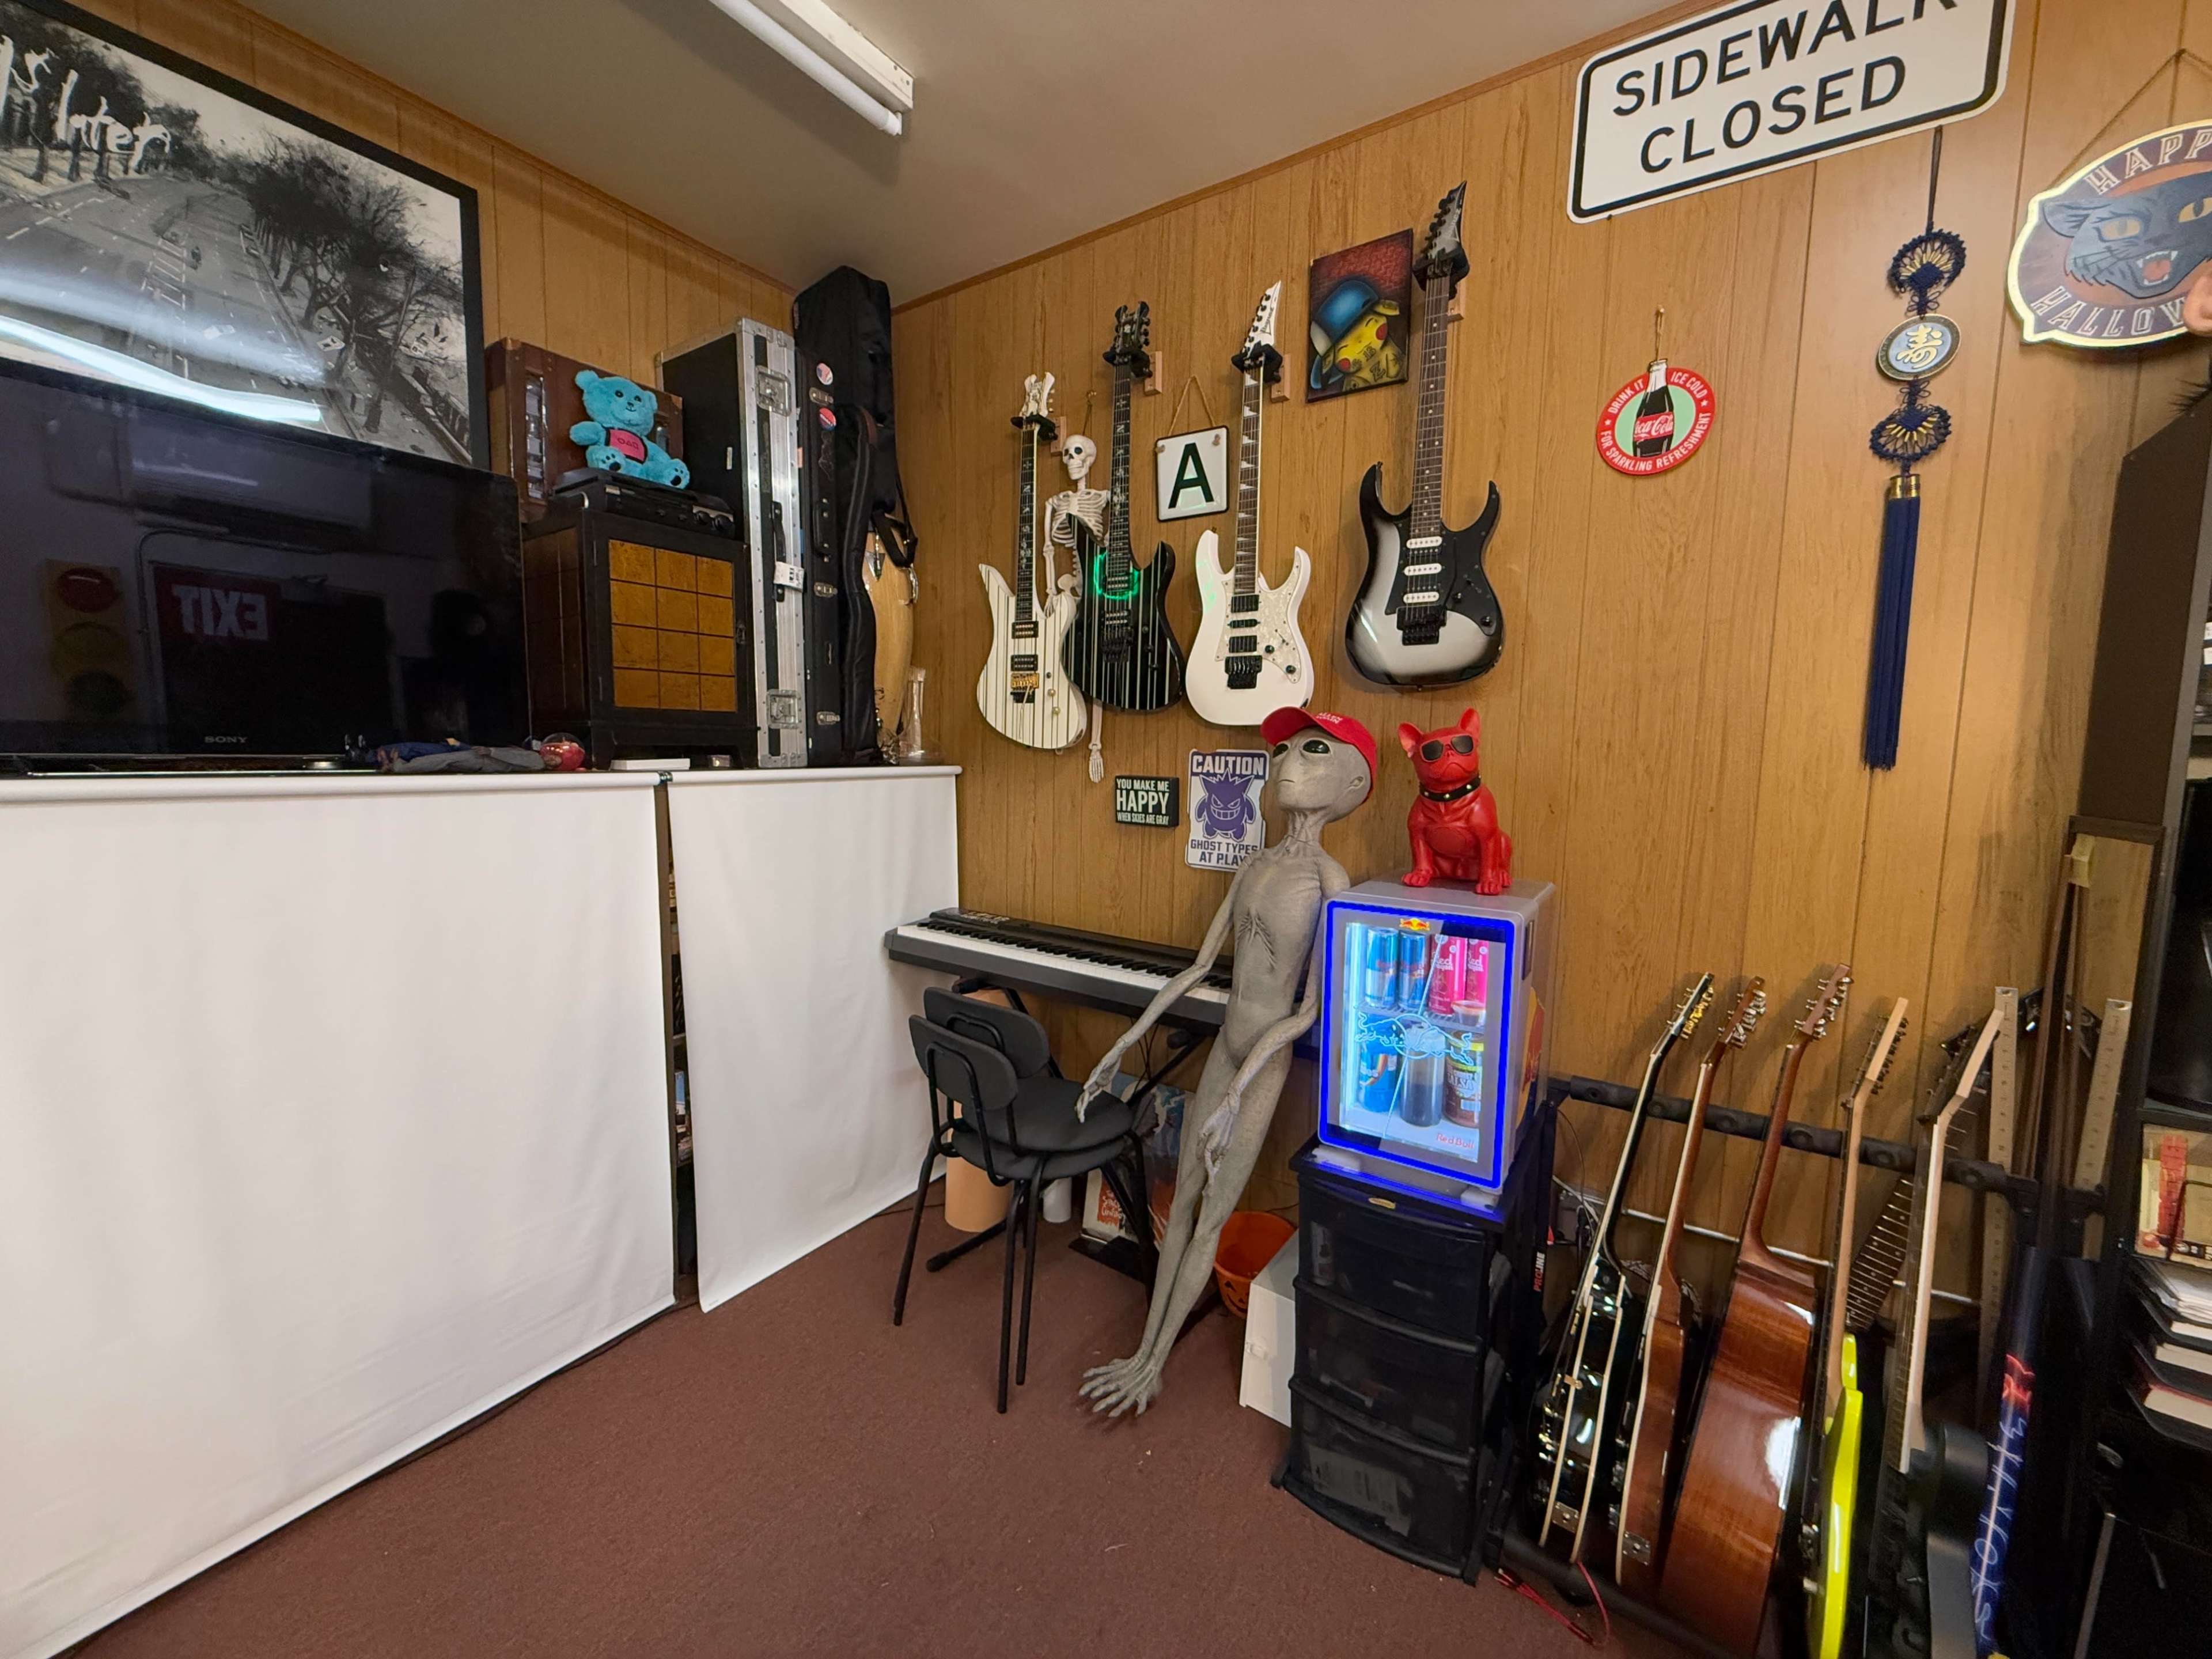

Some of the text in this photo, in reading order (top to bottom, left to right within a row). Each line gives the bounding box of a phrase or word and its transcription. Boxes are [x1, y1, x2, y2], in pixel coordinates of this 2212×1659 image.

[1640, 56, 1906, 173] CLOSED
[1608, 370, 1708, 415] DRINK IT ICE COLD
[1600, 412, 1711, 471] FOR SPARKLING REFRESHMENT
[1168, 442, 1215, 509] A
[1192, 755, 1264, 776] CAUTION
[1116, 778, 1169, 792] YOU MAKE ME
[1116, 789, 1170, 814] HAPPY
[1117, 812, 1169, 825] WHEN SKIES ARE GRAY
[1190, 839, 1258, 855] GHOST TYPES
[1199, 851, 1214, 863] AT
[1533, 1251, 1546, 1292] PROLINE
